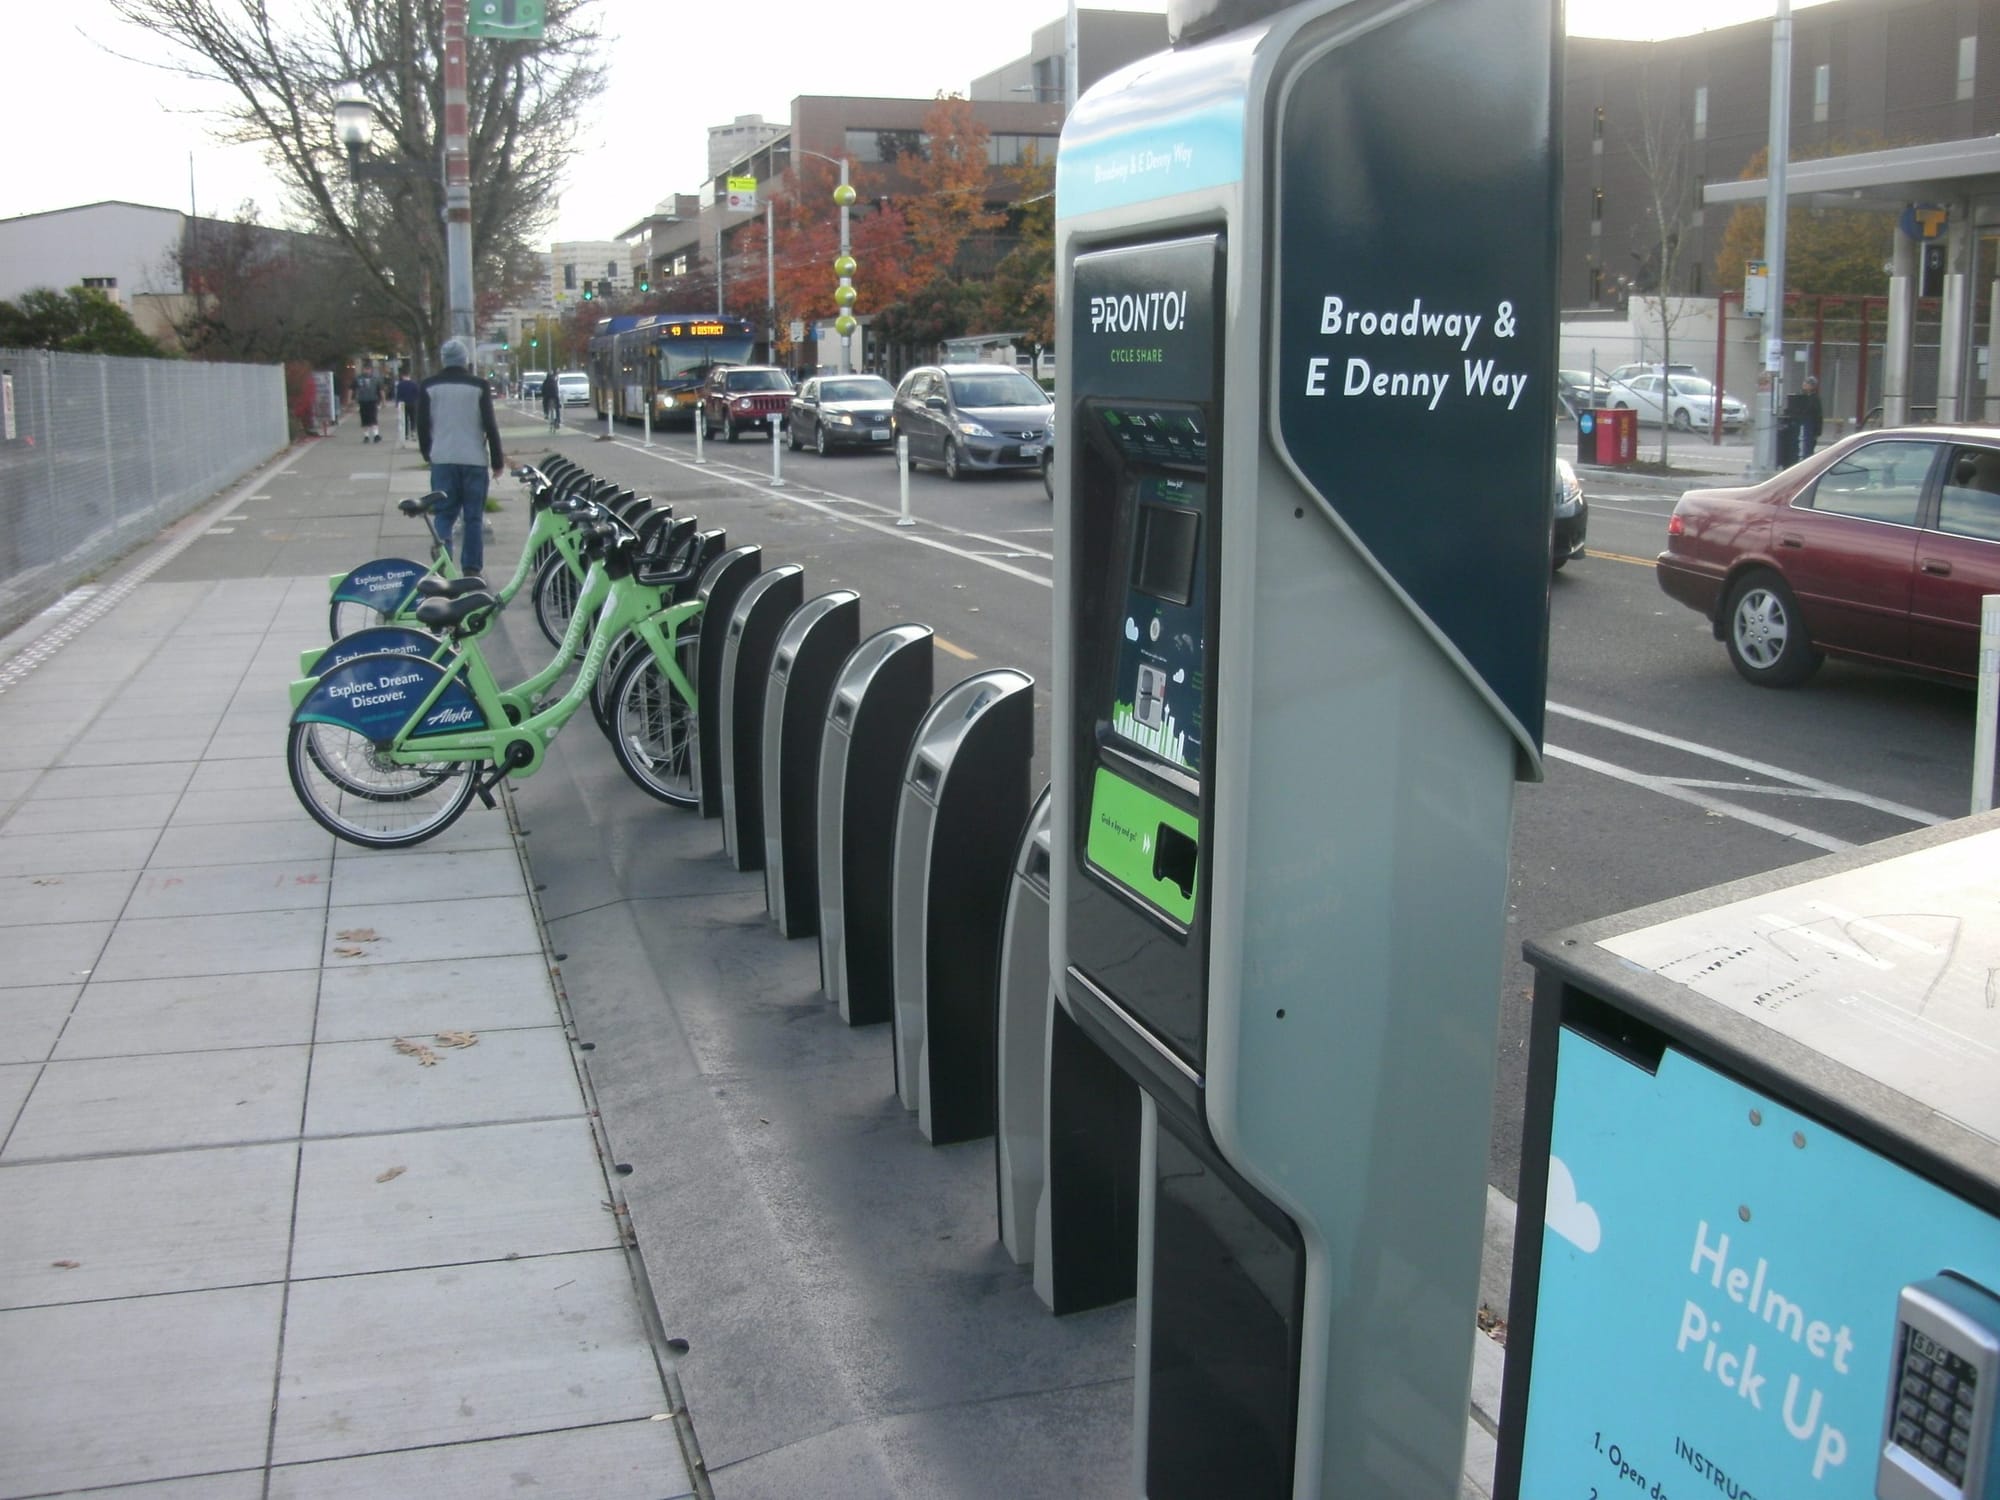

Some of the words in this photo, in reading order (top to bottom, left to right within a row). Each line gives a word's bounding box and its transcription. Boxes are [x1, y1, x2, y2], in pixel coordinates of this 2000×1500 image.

[1090, 290, 1187, 333] PRONTO!
[1319, 296, 1481, 352] Broadway
[1493, 301, 1516, 339] &
[1110, 348, 1134, 362] CYCLE
[1136, 348, 1163, 362] SHARE
[1305, 358, 1330, 397] E
[1343, 357, 1449, 411] Denny
[1463, 359, 1528, 411] Way
[354, 573, 387, 586] Explore.
[387, 569, 416, 580] Dream.
[369, 580, 405, 593] Discover.
[329, 680, 377, 698] Explore.
[379, 672, 424, 689] Dream.
[352, 690, 407, 708] Discover.
[427, 706, 473, 726] Alaska
[1689, 1220, 1855, 1375] Helmet
[1676, 1300, 1768, 1411] Pick
[1782, 1373, 1848, 1480] Up
[1594, 1431, 1603, 1454] 1.
[1609, 1444, 1646, 1489] Open
